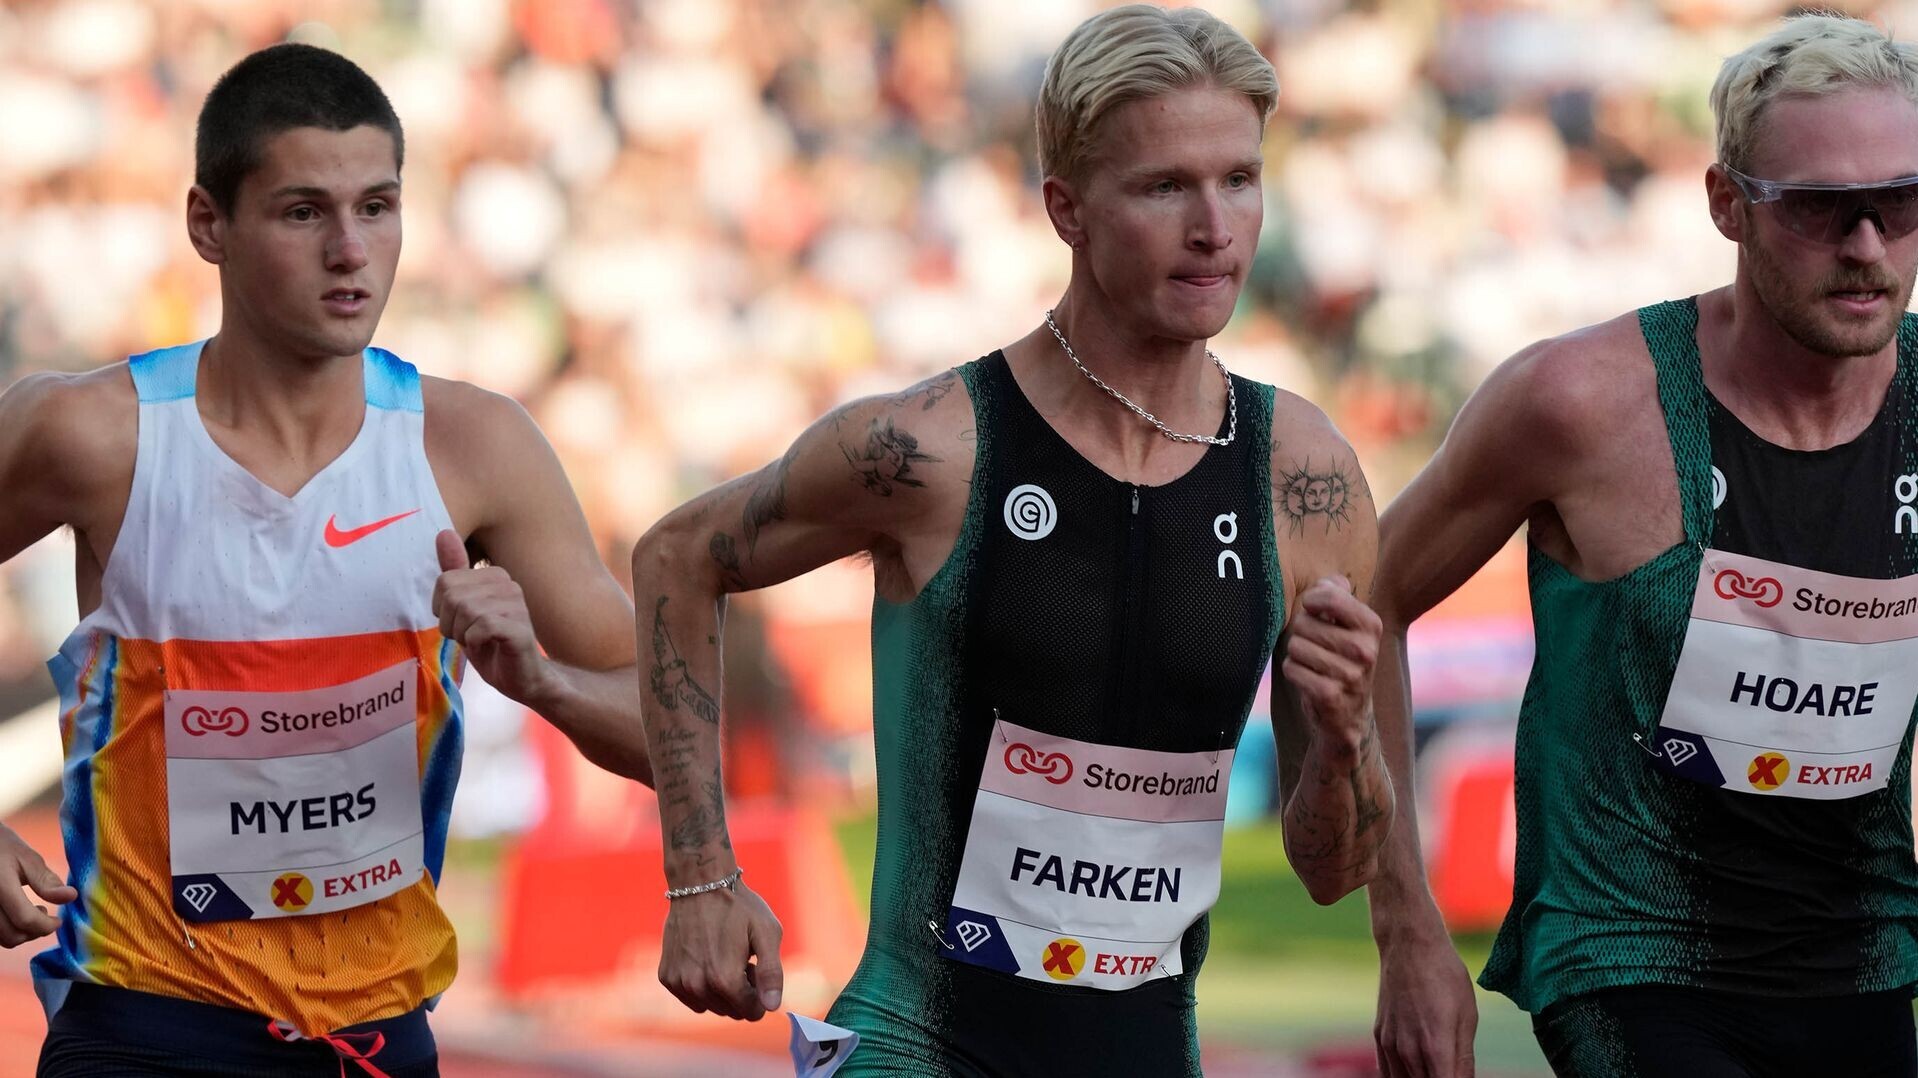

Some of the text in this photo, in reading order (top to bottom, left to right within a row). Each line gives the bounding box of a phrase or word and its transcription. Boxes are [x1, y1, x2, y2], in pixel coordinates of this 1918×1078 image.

[1793, 588, 1918, 620] Storebran
[260, 680, 405, 734] Storebrand
[1730, 671, 1879, 718] HOARE
[1083, 763, 1220, 796] Storebrand
[1797, 763, 1873, 786] EXTRA
[230, 782, 377, 835] MYERS
[323, 858, 403, 898] EXTRA
[1010, 846, 1182, 903] FARKEN
[1094, 953, 1158, 976] EXTR
